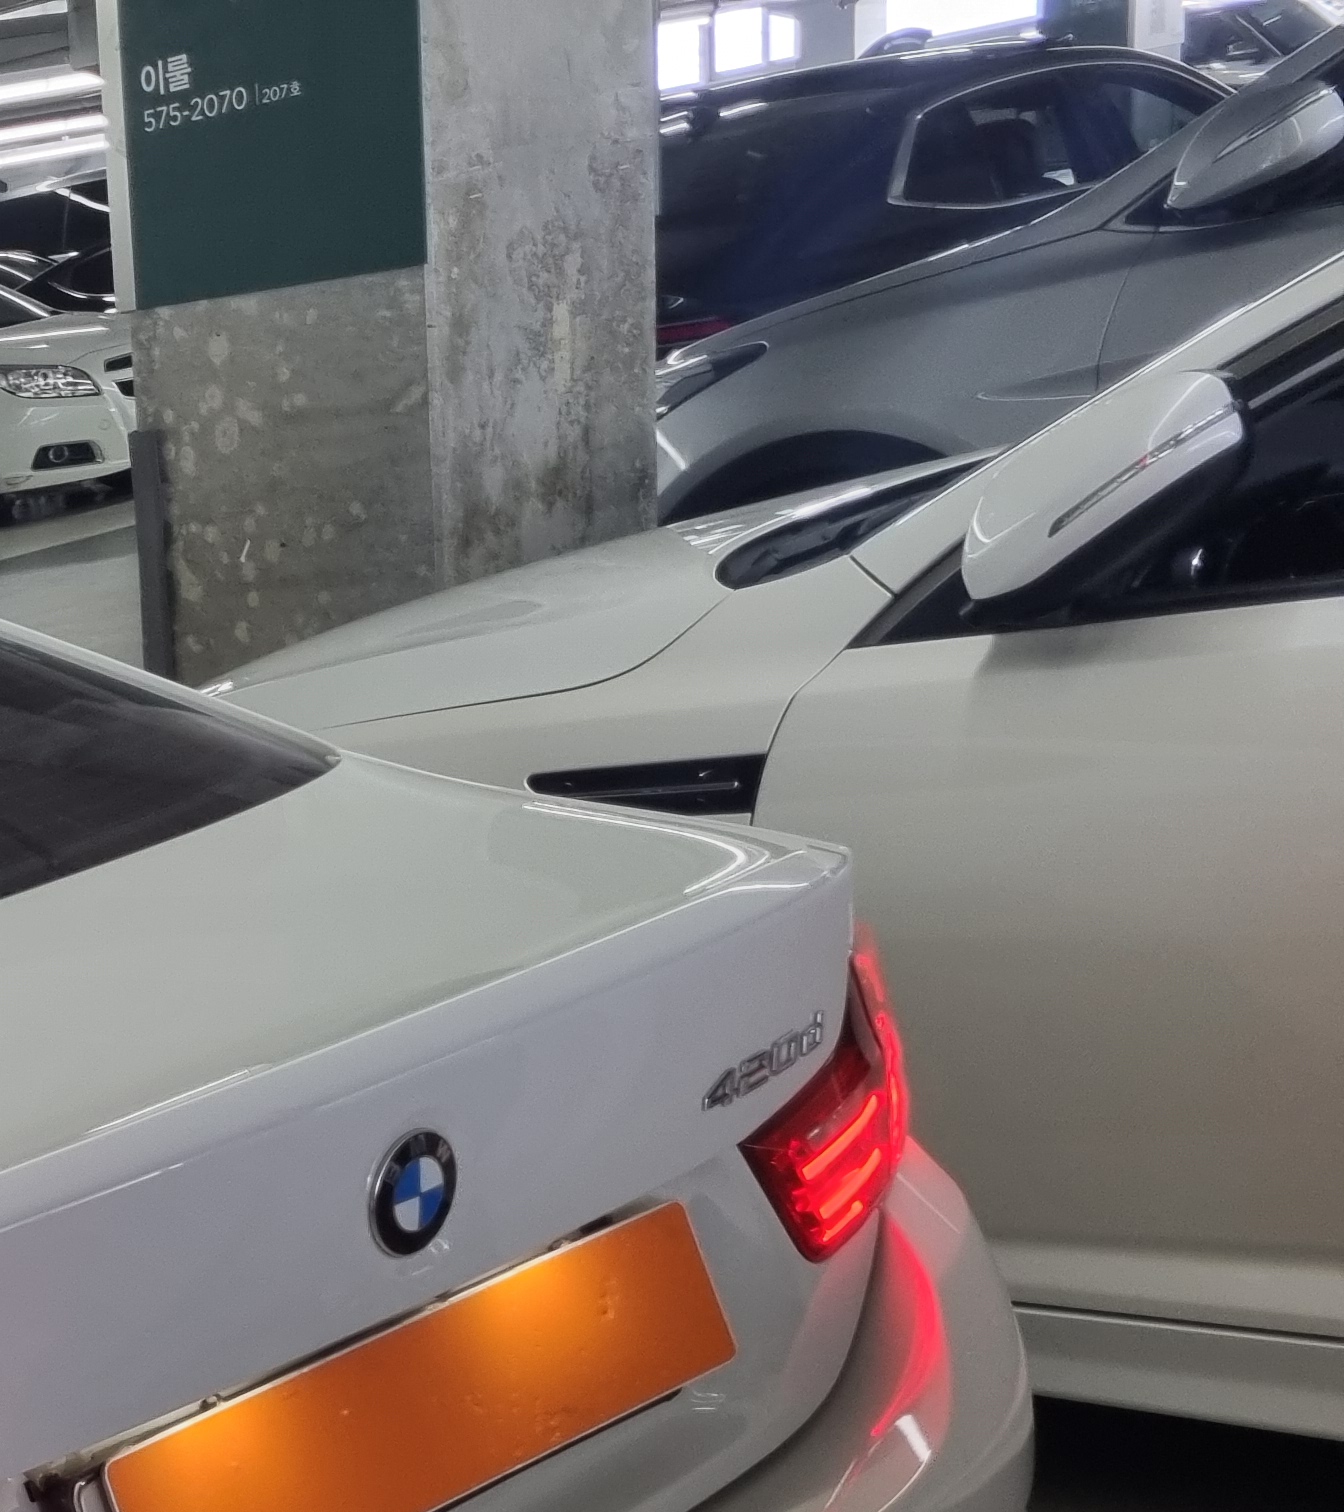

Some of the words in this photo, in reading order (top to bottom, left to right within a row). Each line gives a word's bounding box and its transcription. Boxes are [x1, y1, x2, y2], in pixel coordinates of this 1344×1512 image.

[140, 53, 192, 95] 이룰
[143, 86, 248, 132] 575-2070
[261, 80, 302, 103] 207호
[701, 1009, 824, 1111] 420d
